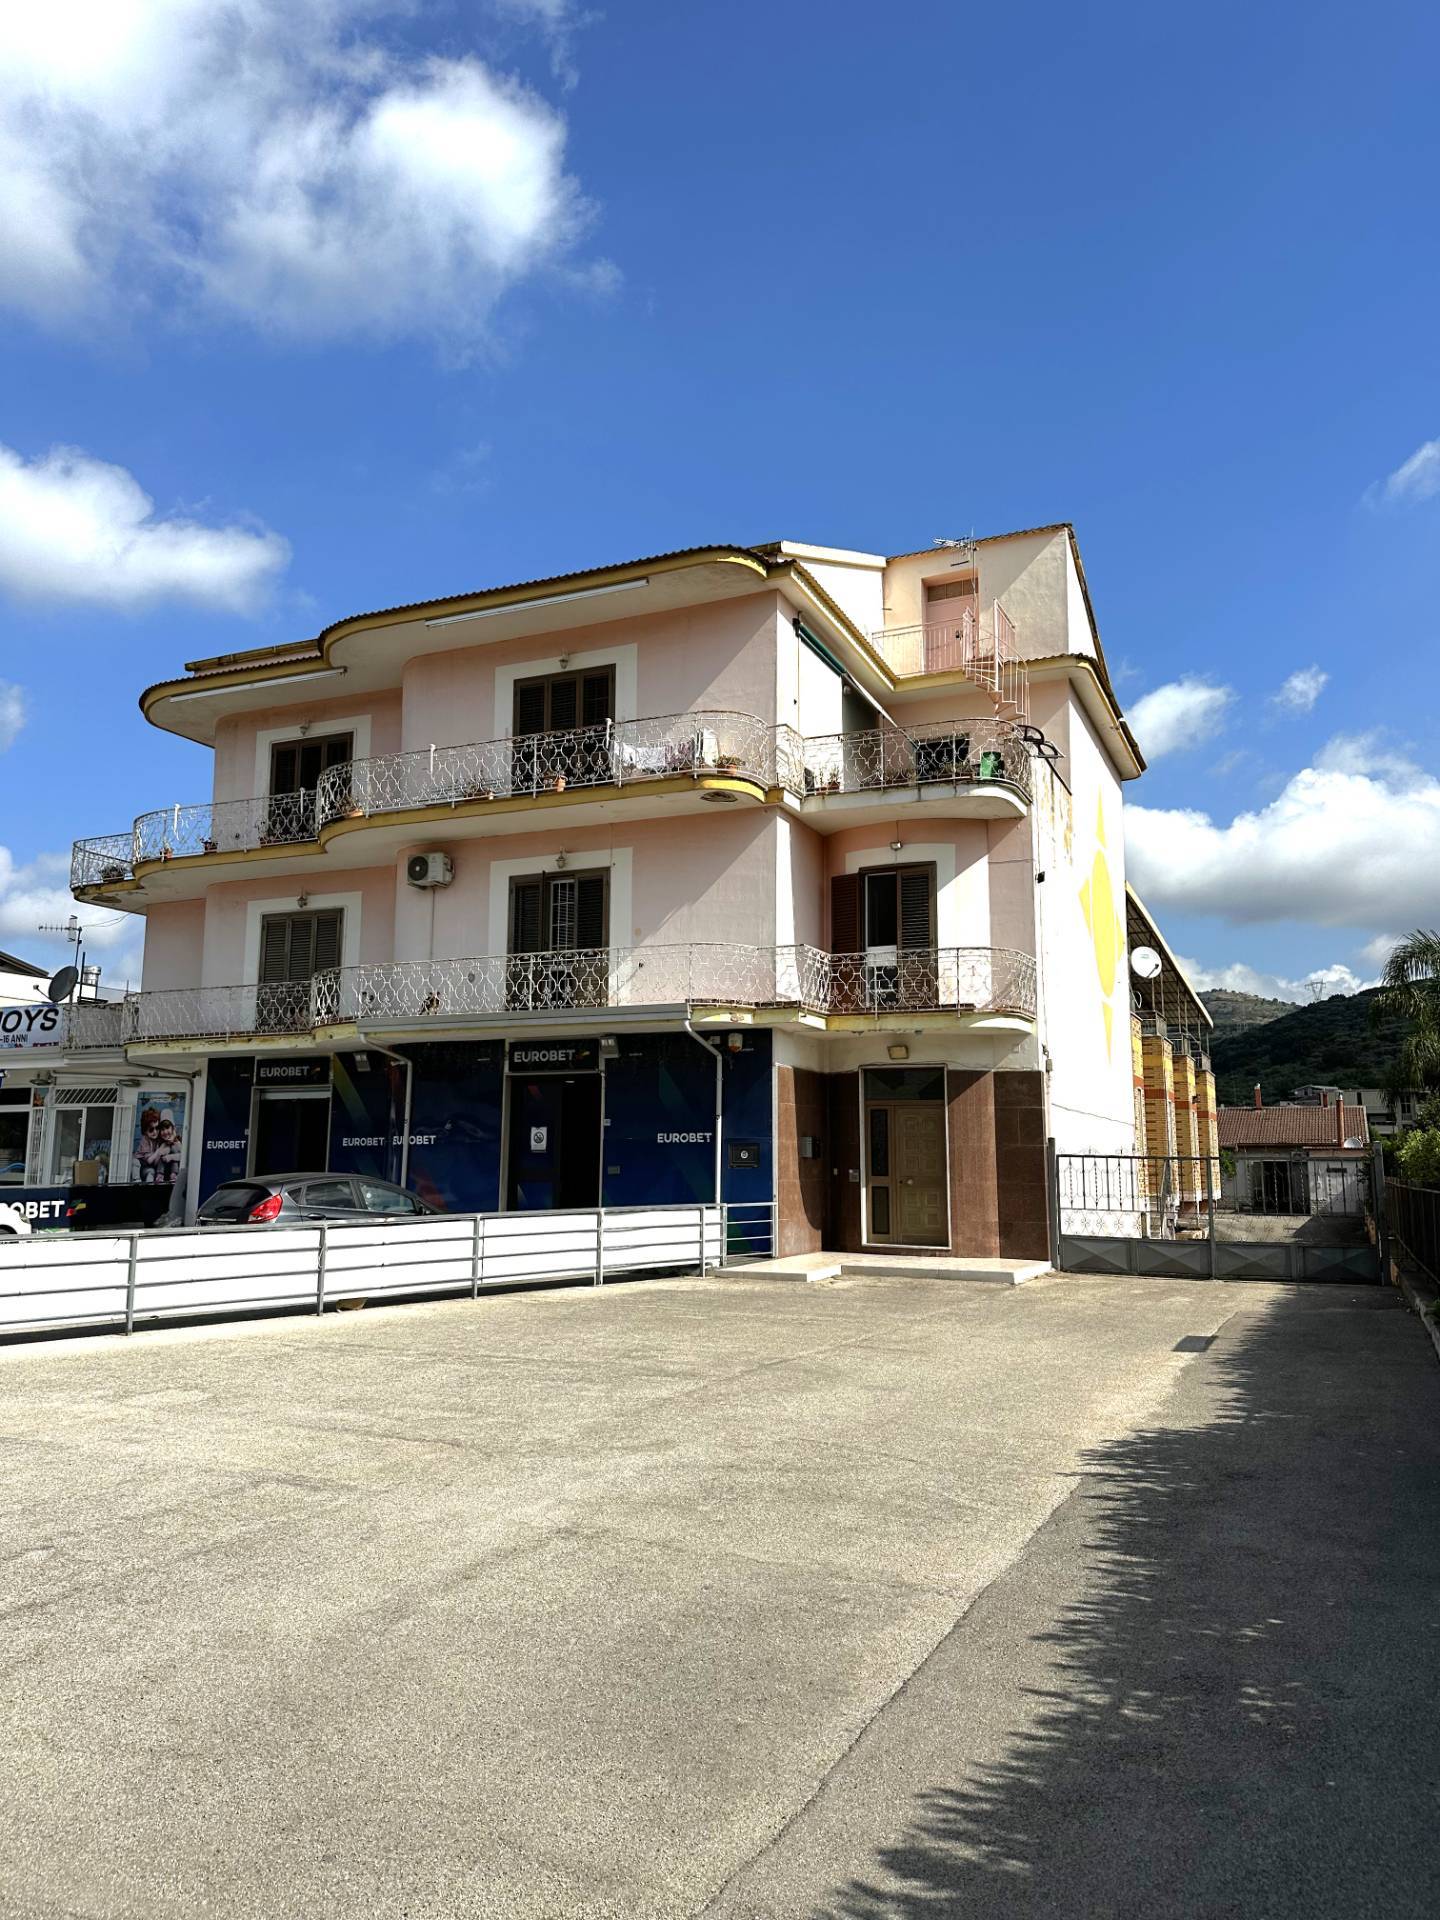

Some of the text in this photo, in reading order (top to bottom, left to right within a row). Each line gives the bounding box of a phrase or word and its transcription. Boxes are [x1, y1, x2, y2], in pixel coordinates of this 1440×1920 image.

[0, 1008, 59, 1033] OYS
[514, 1049, 575, 1062] EUROBET
[260, 1066, 310, 1077] EUROBET
[342, 1137, 385, 1147] EUROBET
[392, 1135, 436, 1145] EUOBET
[657, 1132, 712, 1143] EUROBET
[207, 1140, 246, 1149] EUROBET
